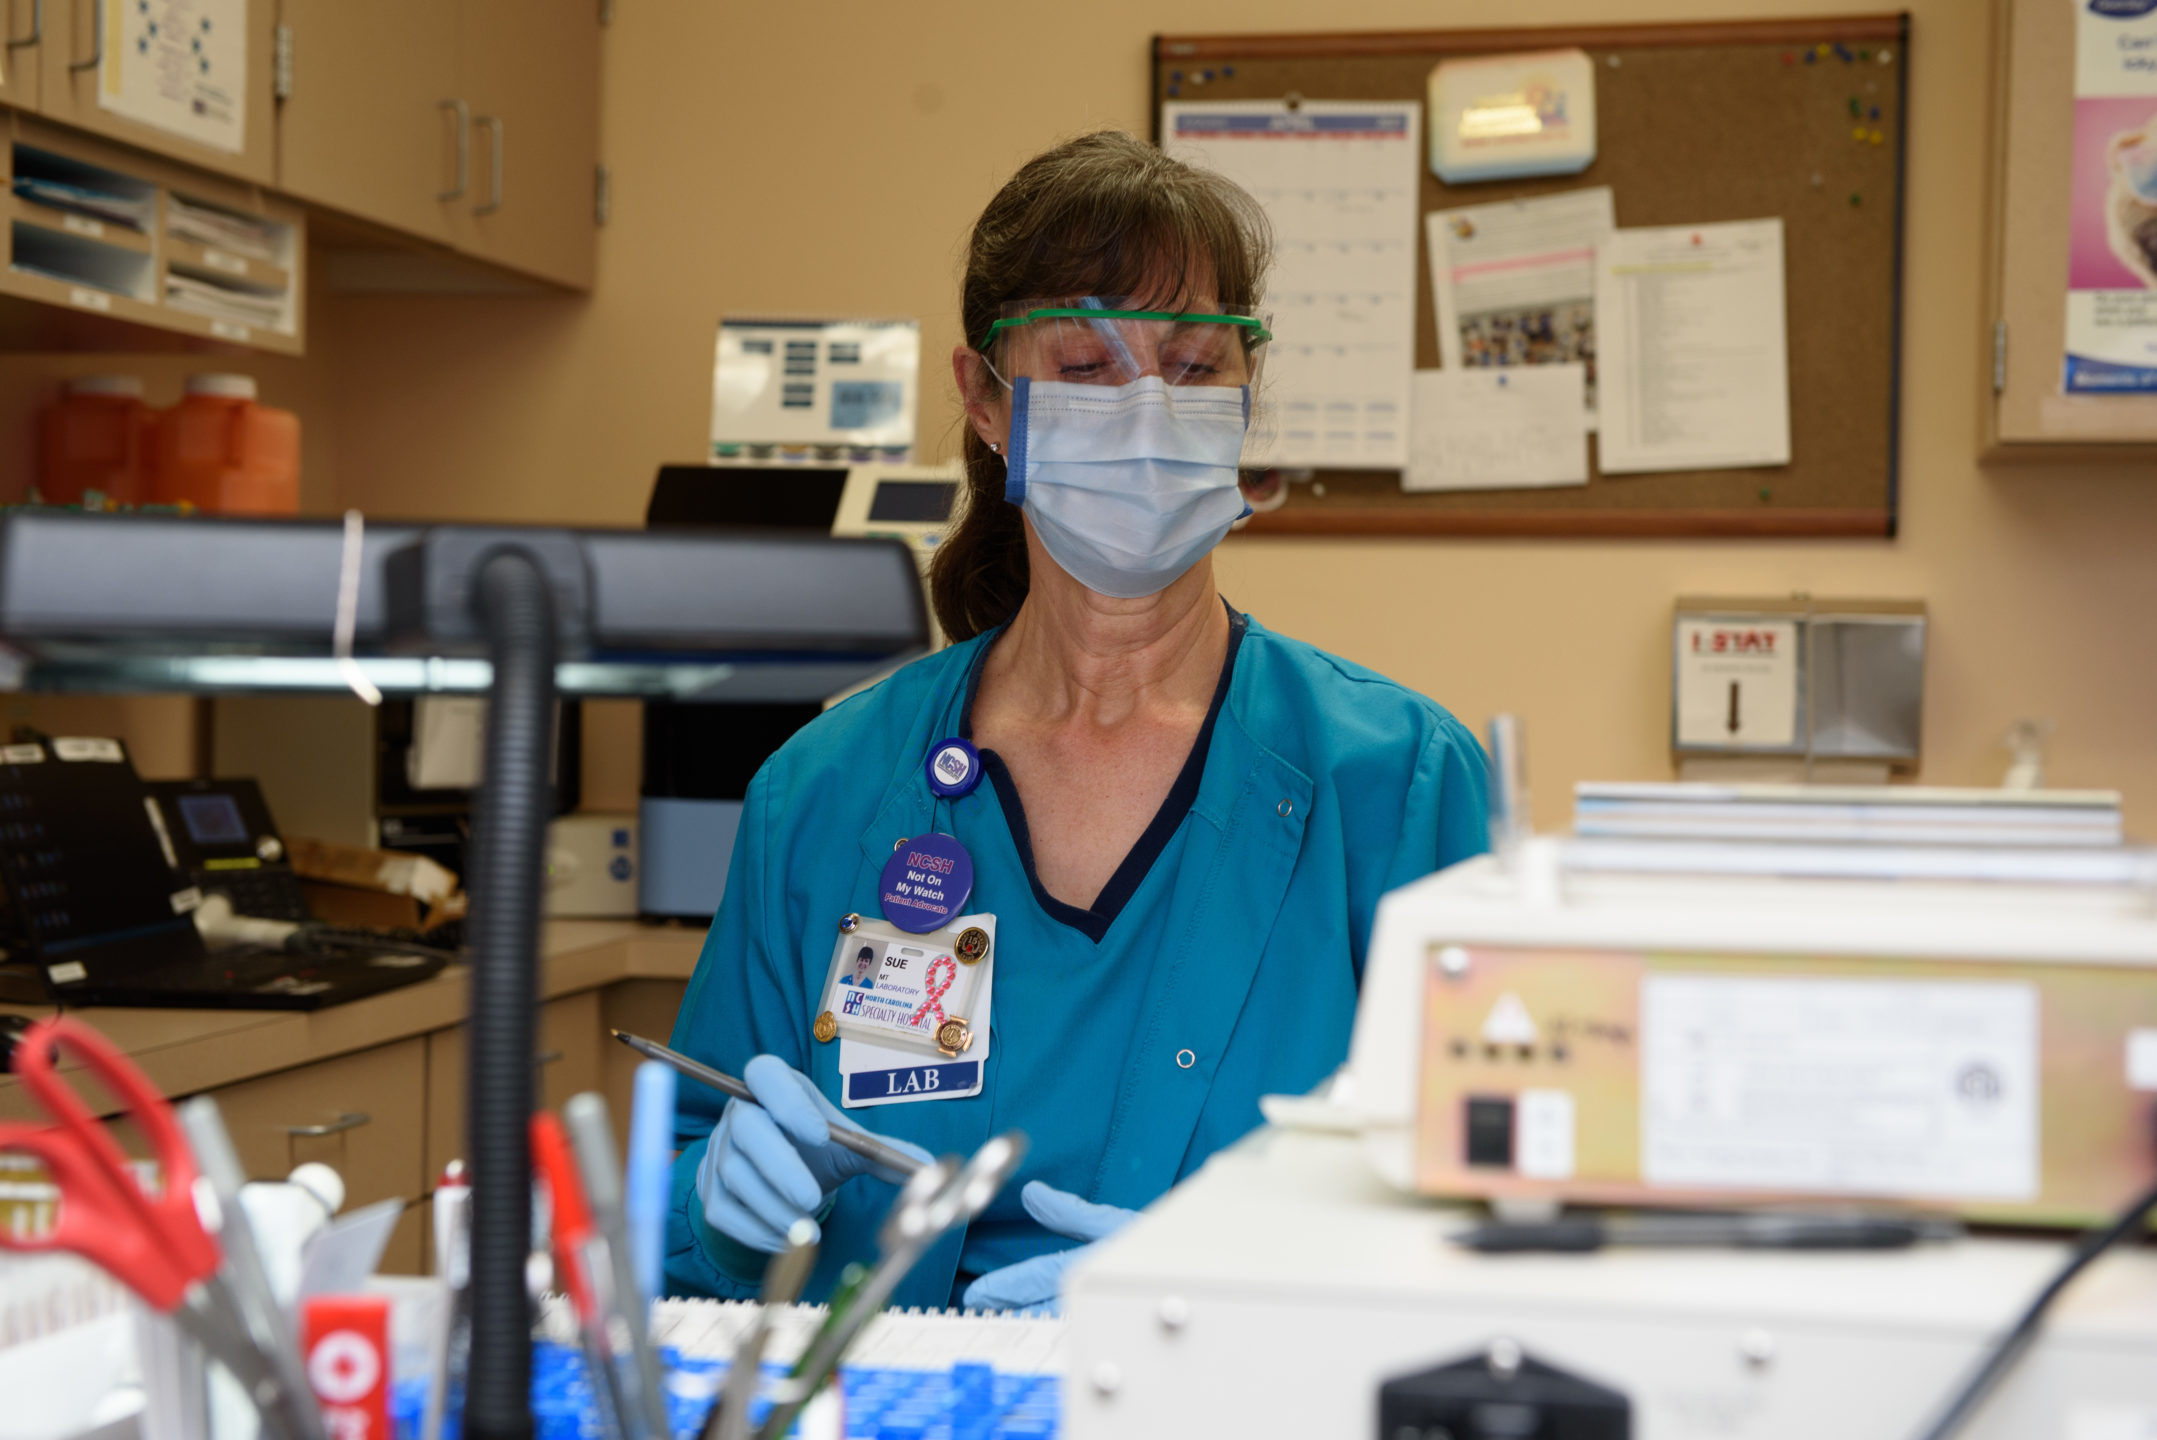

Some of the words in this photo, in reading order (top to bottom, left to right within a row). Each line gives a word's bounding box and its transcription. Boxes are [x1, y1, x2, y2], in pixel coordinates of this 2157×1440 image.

[939, 751, 967, 777] NCSH
[907, 851, 954, 874] NCSH
[907, 870, 926, 883] Not
[927, 875, 942, 886] On
[896, 882, 912, 896] My
[913, 885, 945, 901] Watch
[885, 892, 912, 906] Patient
[911, 899, 948, 914] Advocate
[885, 956, 909, 969] SUE
[875, 983, 920, 996] LABORATORY
[865, 994, 885, 1004] NORTH
[884, 997, 913, 1009] CAROLINA
[861, 1004, 897, 1022] SPECIALTY
[886, 1068, 940, 1095] LAB
